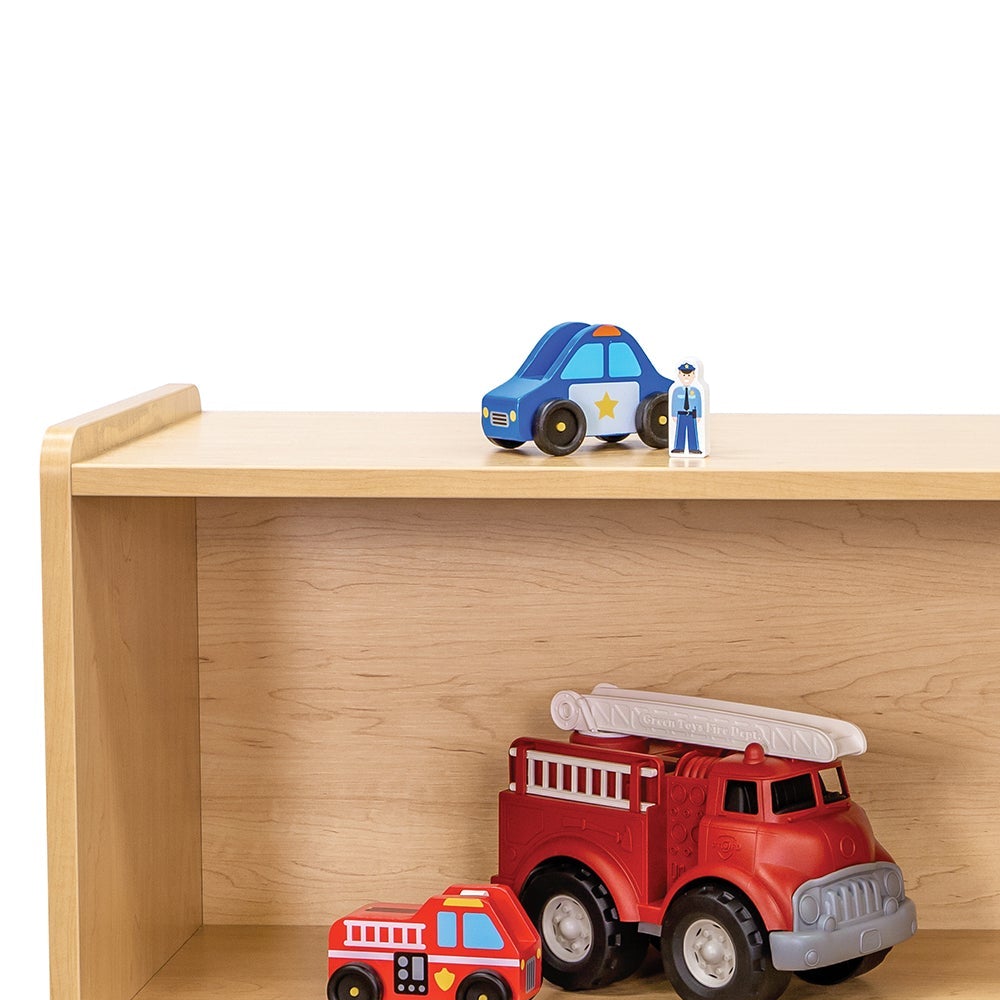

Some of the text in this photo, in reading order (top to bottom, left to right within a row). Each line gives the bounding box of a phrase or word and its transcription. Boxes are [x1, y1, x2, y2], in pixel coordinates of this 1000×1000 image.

[643, 714, 762, 741] Green Toys Fire Dept.
